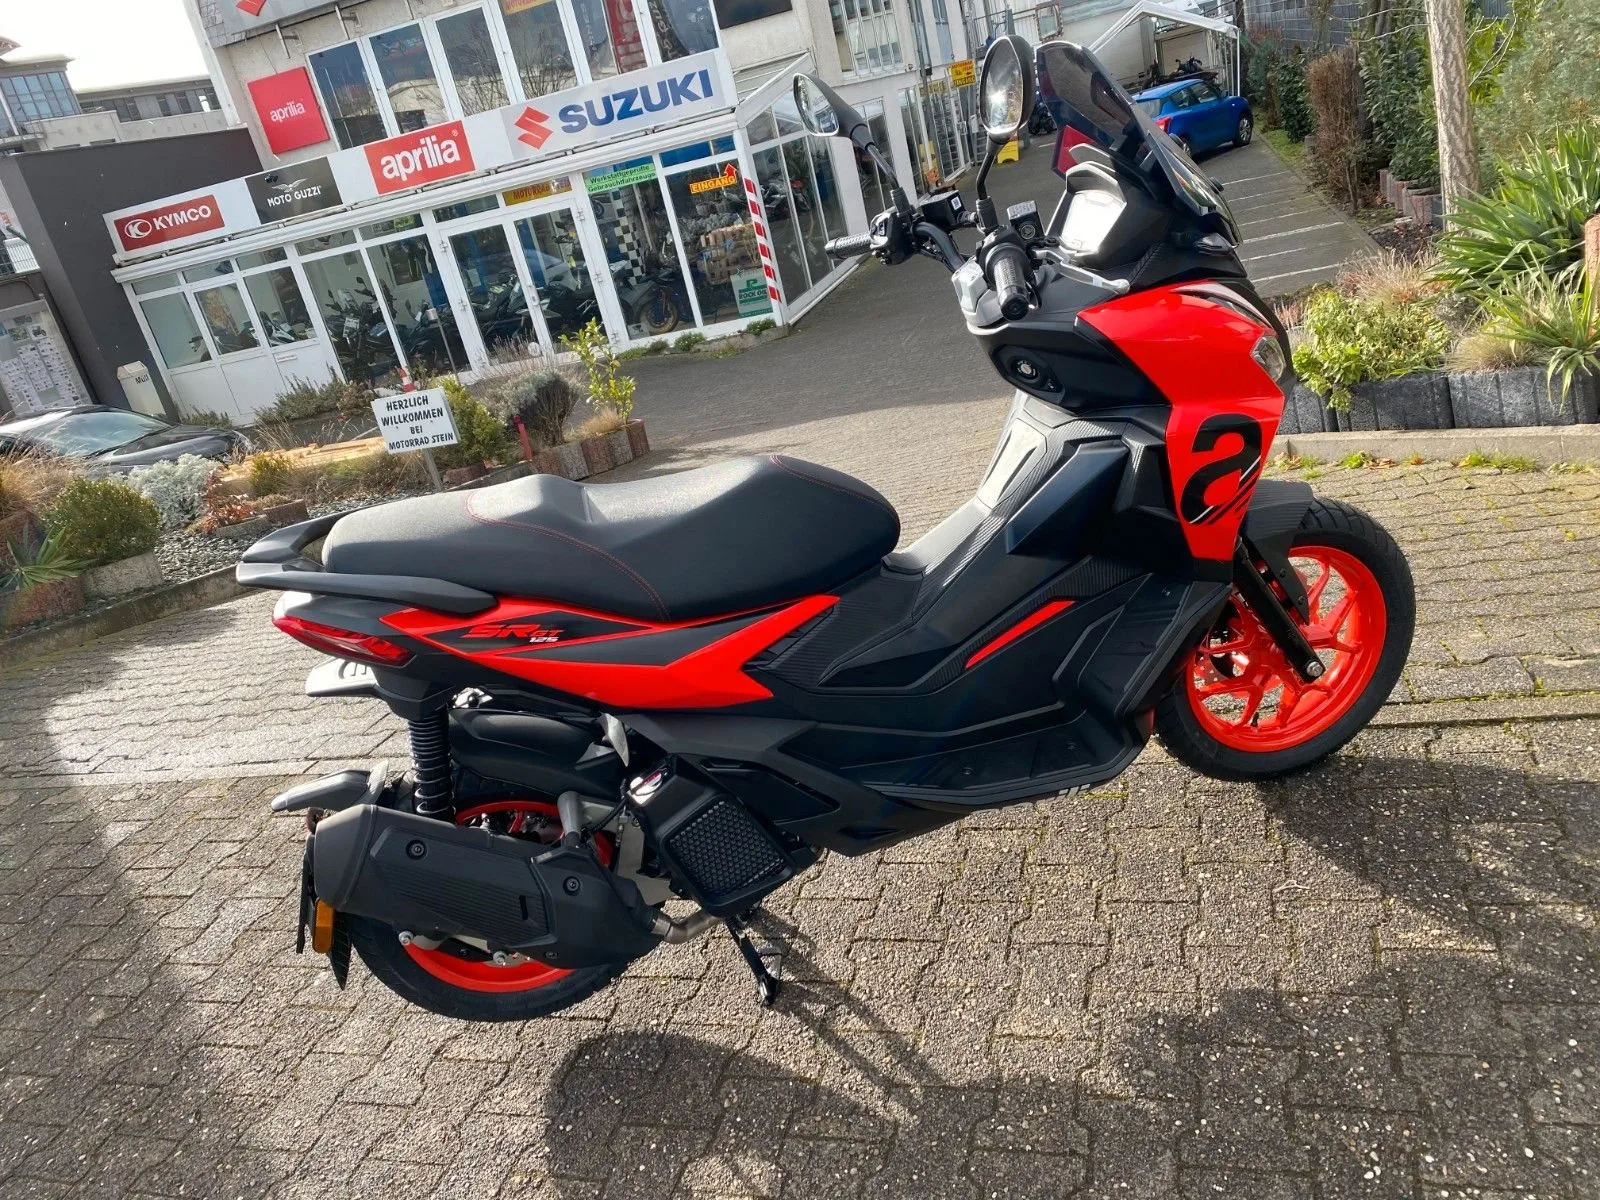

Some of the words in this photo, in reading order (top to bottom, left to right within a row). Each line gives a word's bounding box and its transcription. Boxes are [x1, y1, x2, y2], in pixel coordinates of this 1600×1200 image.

[270, 100, 306, 122] aprilia
[558, 69, 714, 134] SUZUKI
[380, 135, 461, 181] aprilia
[691, 176, 735, 191] EINGANG
[267, 193, 292, 207] MOTO
[294, 186, 321, 200] GUZZI
[152, 205, 212, 230] KYMCO
[386, 395, 429, 412] HERZLICH
[381, 407, 444, 426] WILLKOMMEN
[410, 425, 423, 435] BEI
[388, 436, 430, 450] MOTORRAD
[431, 432, 454, 444] STEIN
